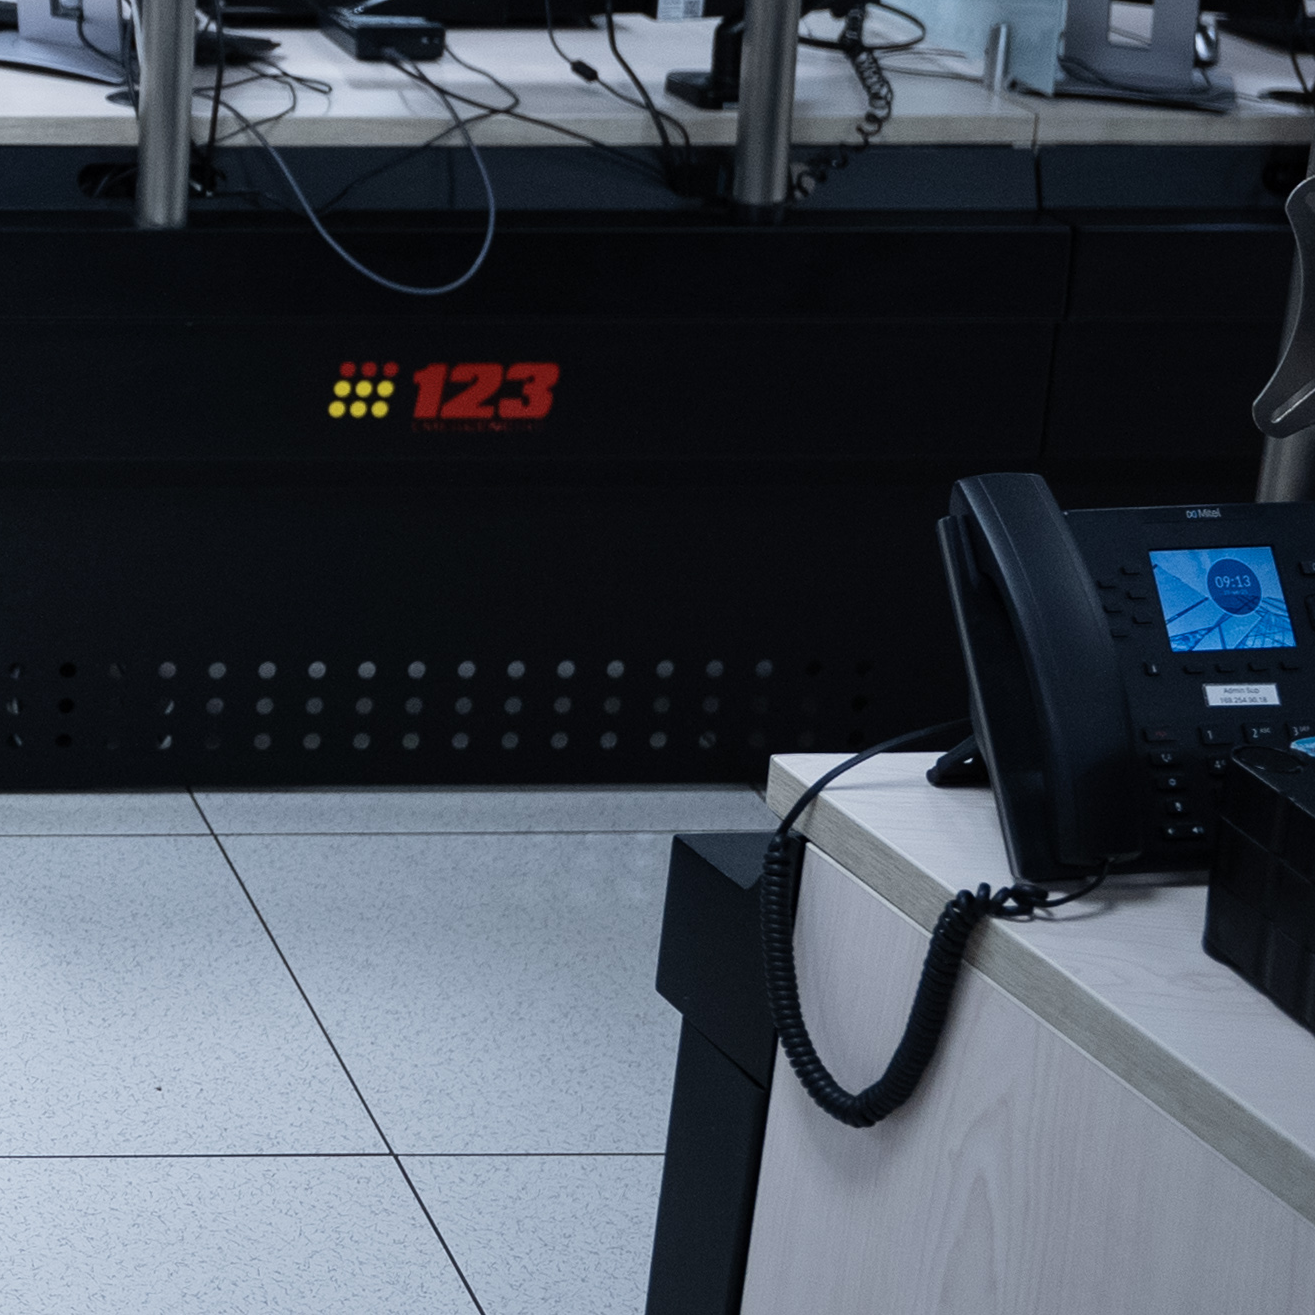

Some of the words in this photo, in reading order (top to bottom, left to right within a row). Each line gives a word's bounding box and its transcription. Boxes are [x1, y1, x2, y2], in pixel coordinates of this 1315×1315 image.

[413, 362, 561, 419] 123
[1198, 508, 1222, 519] Mitel
[1214, 574, 1252, 589] 09:13
[1251, 728, 1259, 739] 2
[1292, 726, 1300, 736] 3
